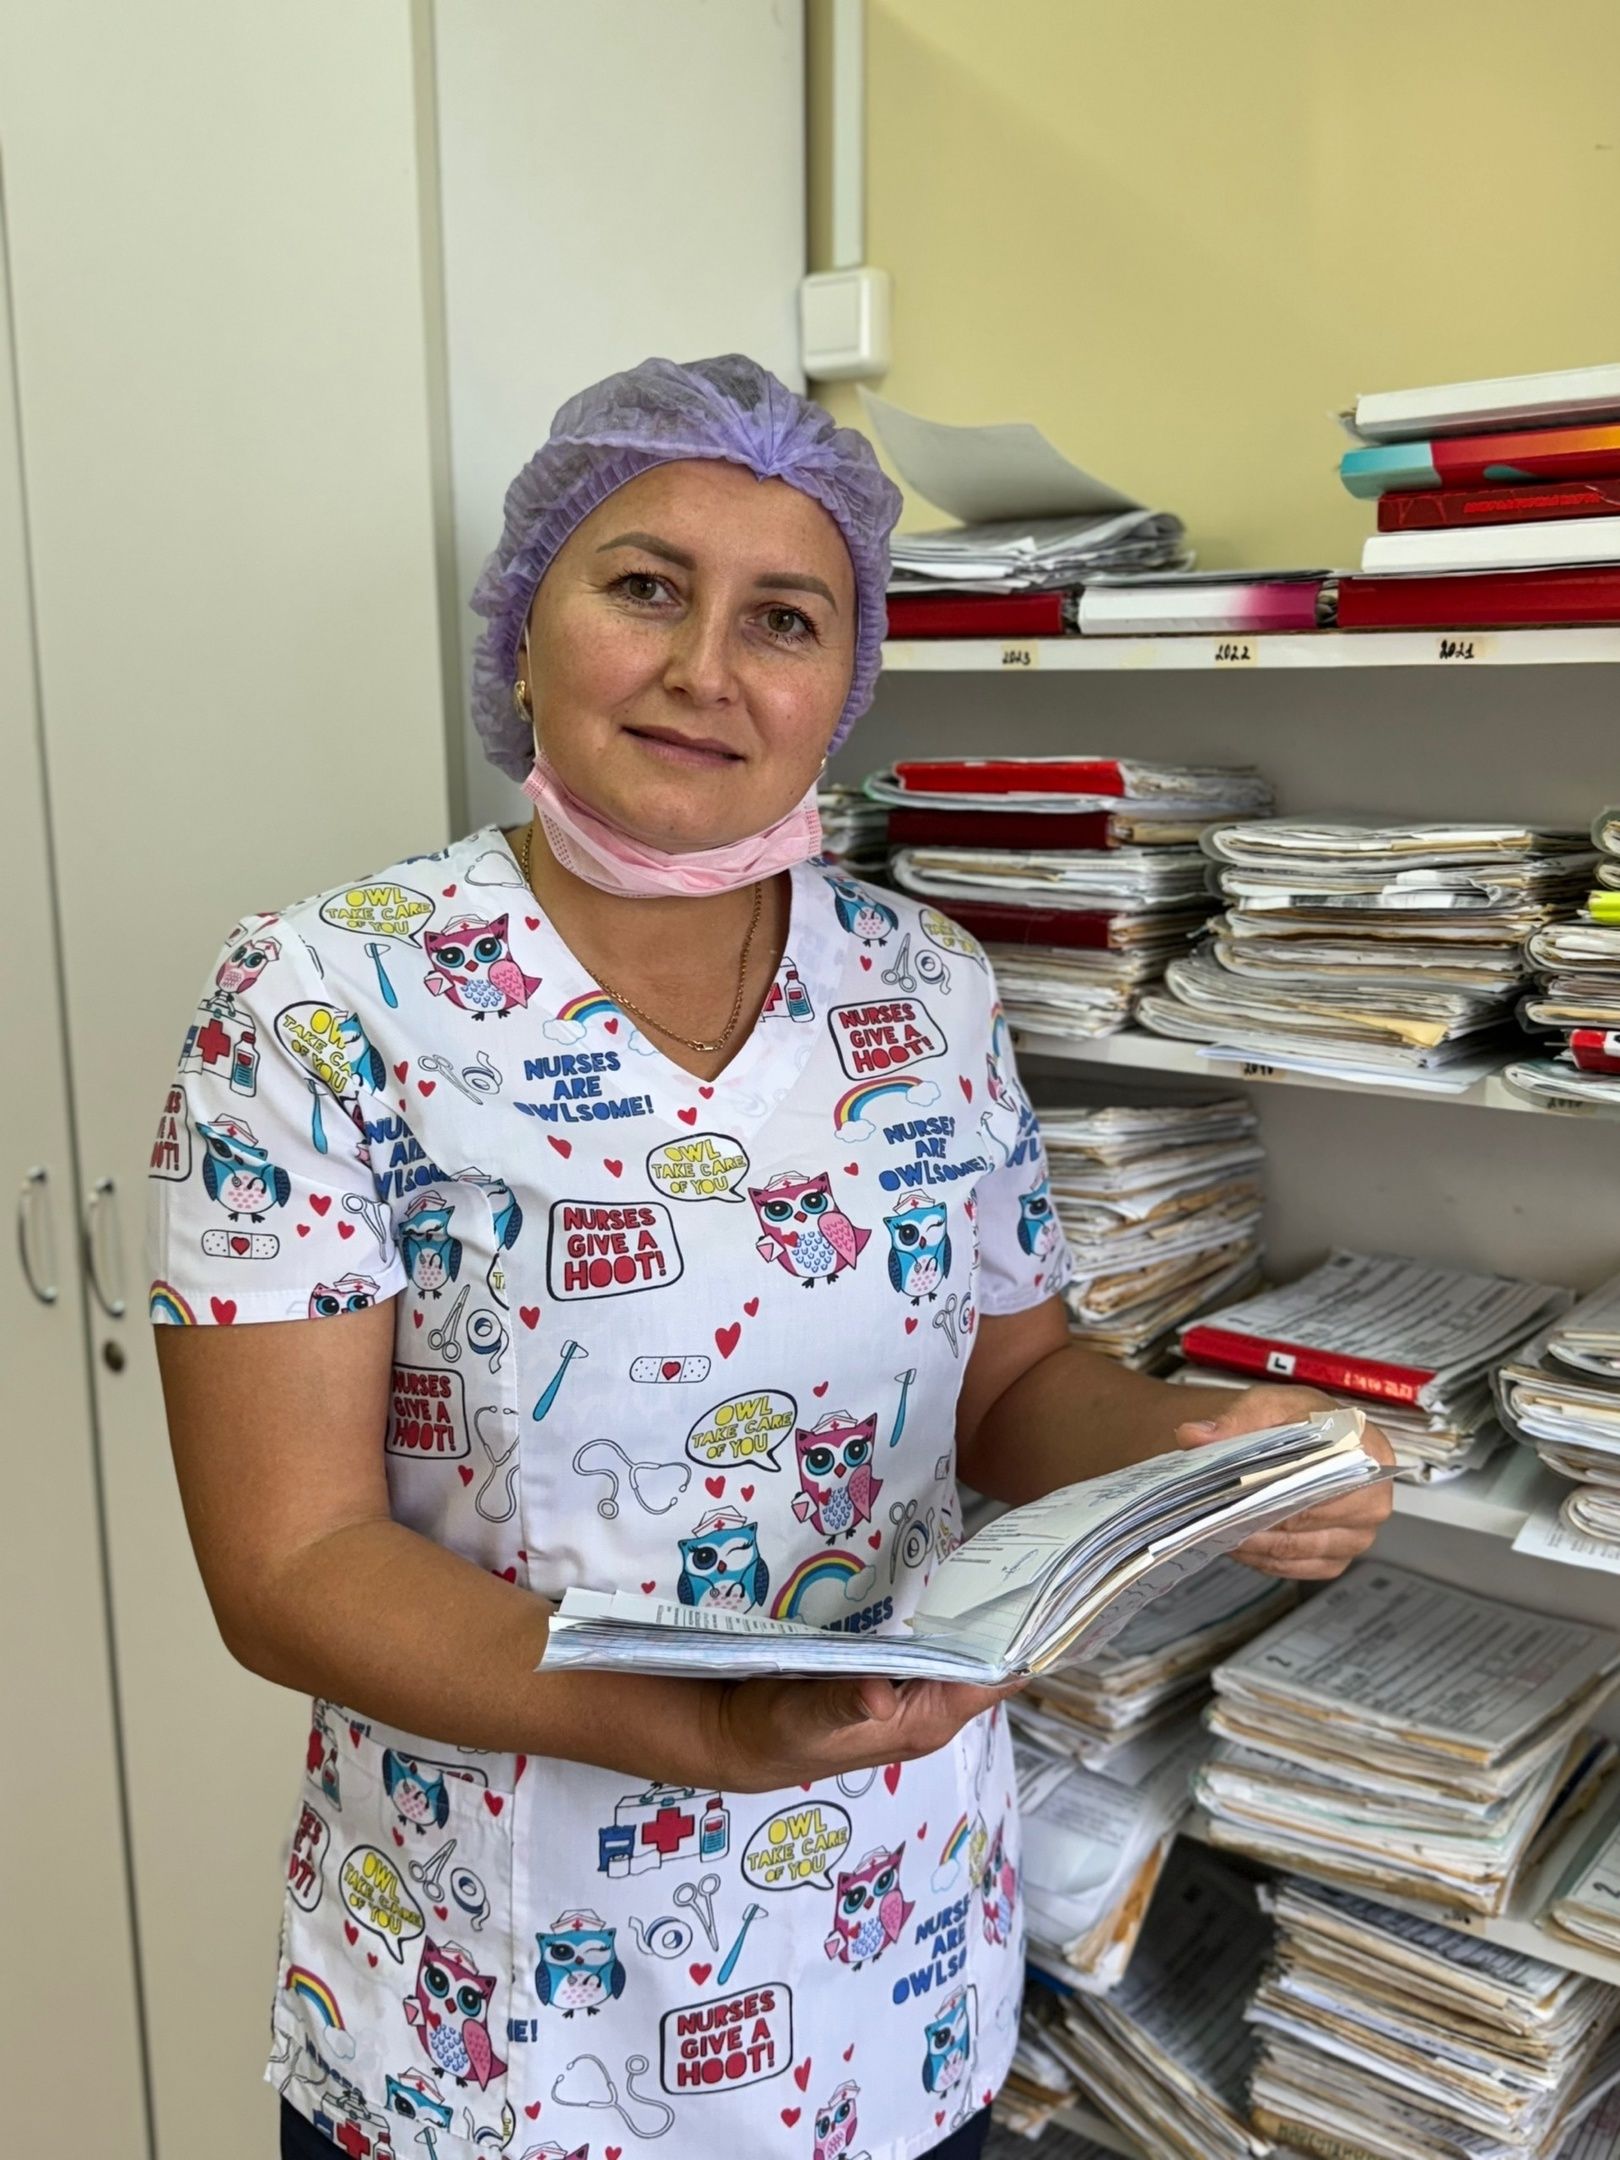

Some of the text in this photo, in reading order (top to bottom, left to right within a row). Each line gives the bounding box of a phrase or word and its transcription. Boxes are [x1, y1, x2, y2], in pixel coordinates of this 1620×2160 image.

[1215, 643, 1251, 661] 2022
[325, 903, 431, 921] TAKE CARE
[345, 887, 407, 907] OWL
[347, 920, 409, 935] OF YOU
[838, 1003, 916, 1029] NURSES
[283, 1014, 328, 1054] TAKE
[849, 1024, 922, 1048] GIVE A
[291, 1039, 347, 1093] OF YOU
[523, 1051, 621, 1081] NURSES
[851, 1035, 935, 1074] HOOT!
[553, 1075, 602, 1101] ARE
[664, 1139, 721, 1162] OWL
[915, 1138, 947, 1159] ARE
[651, 1155, 747, 1179] TAKE CARE
[670, 1176, 729, 1195] OF YOU
[563, 1207, 656, 1231] NURSES
[567, 1230, 658, 1258] GIVE A
[564, 1251, 667, 1292] HOOT!
[394, 1397, 451, 1423] GIVE A
[714, 1395, 773, 1426] OWL
[393, 1418, 456, 1452] HOOT!
[692, 1411, 793, 1448] TAKE CARE
[706, 1433, 768, 1459] OF YOU
[768, 1808, 827, 1845] OWL
[747, 1826, 848, 1871] TAKE CARE
[344, 1862, 374, 1901] TAKE
[363, 1852, 400, 1904] OWL
[765, 1853, 826, 1883] OF YOU
[369, 1902, 401, 1935] YOU
[931, 1920, 966, 1960] ARE
[677, 1990, 775, 2036] NURSES
[681, 2017, 771, 2059] GIVE A
[677, 2040, 775, 2087] HOOT!
